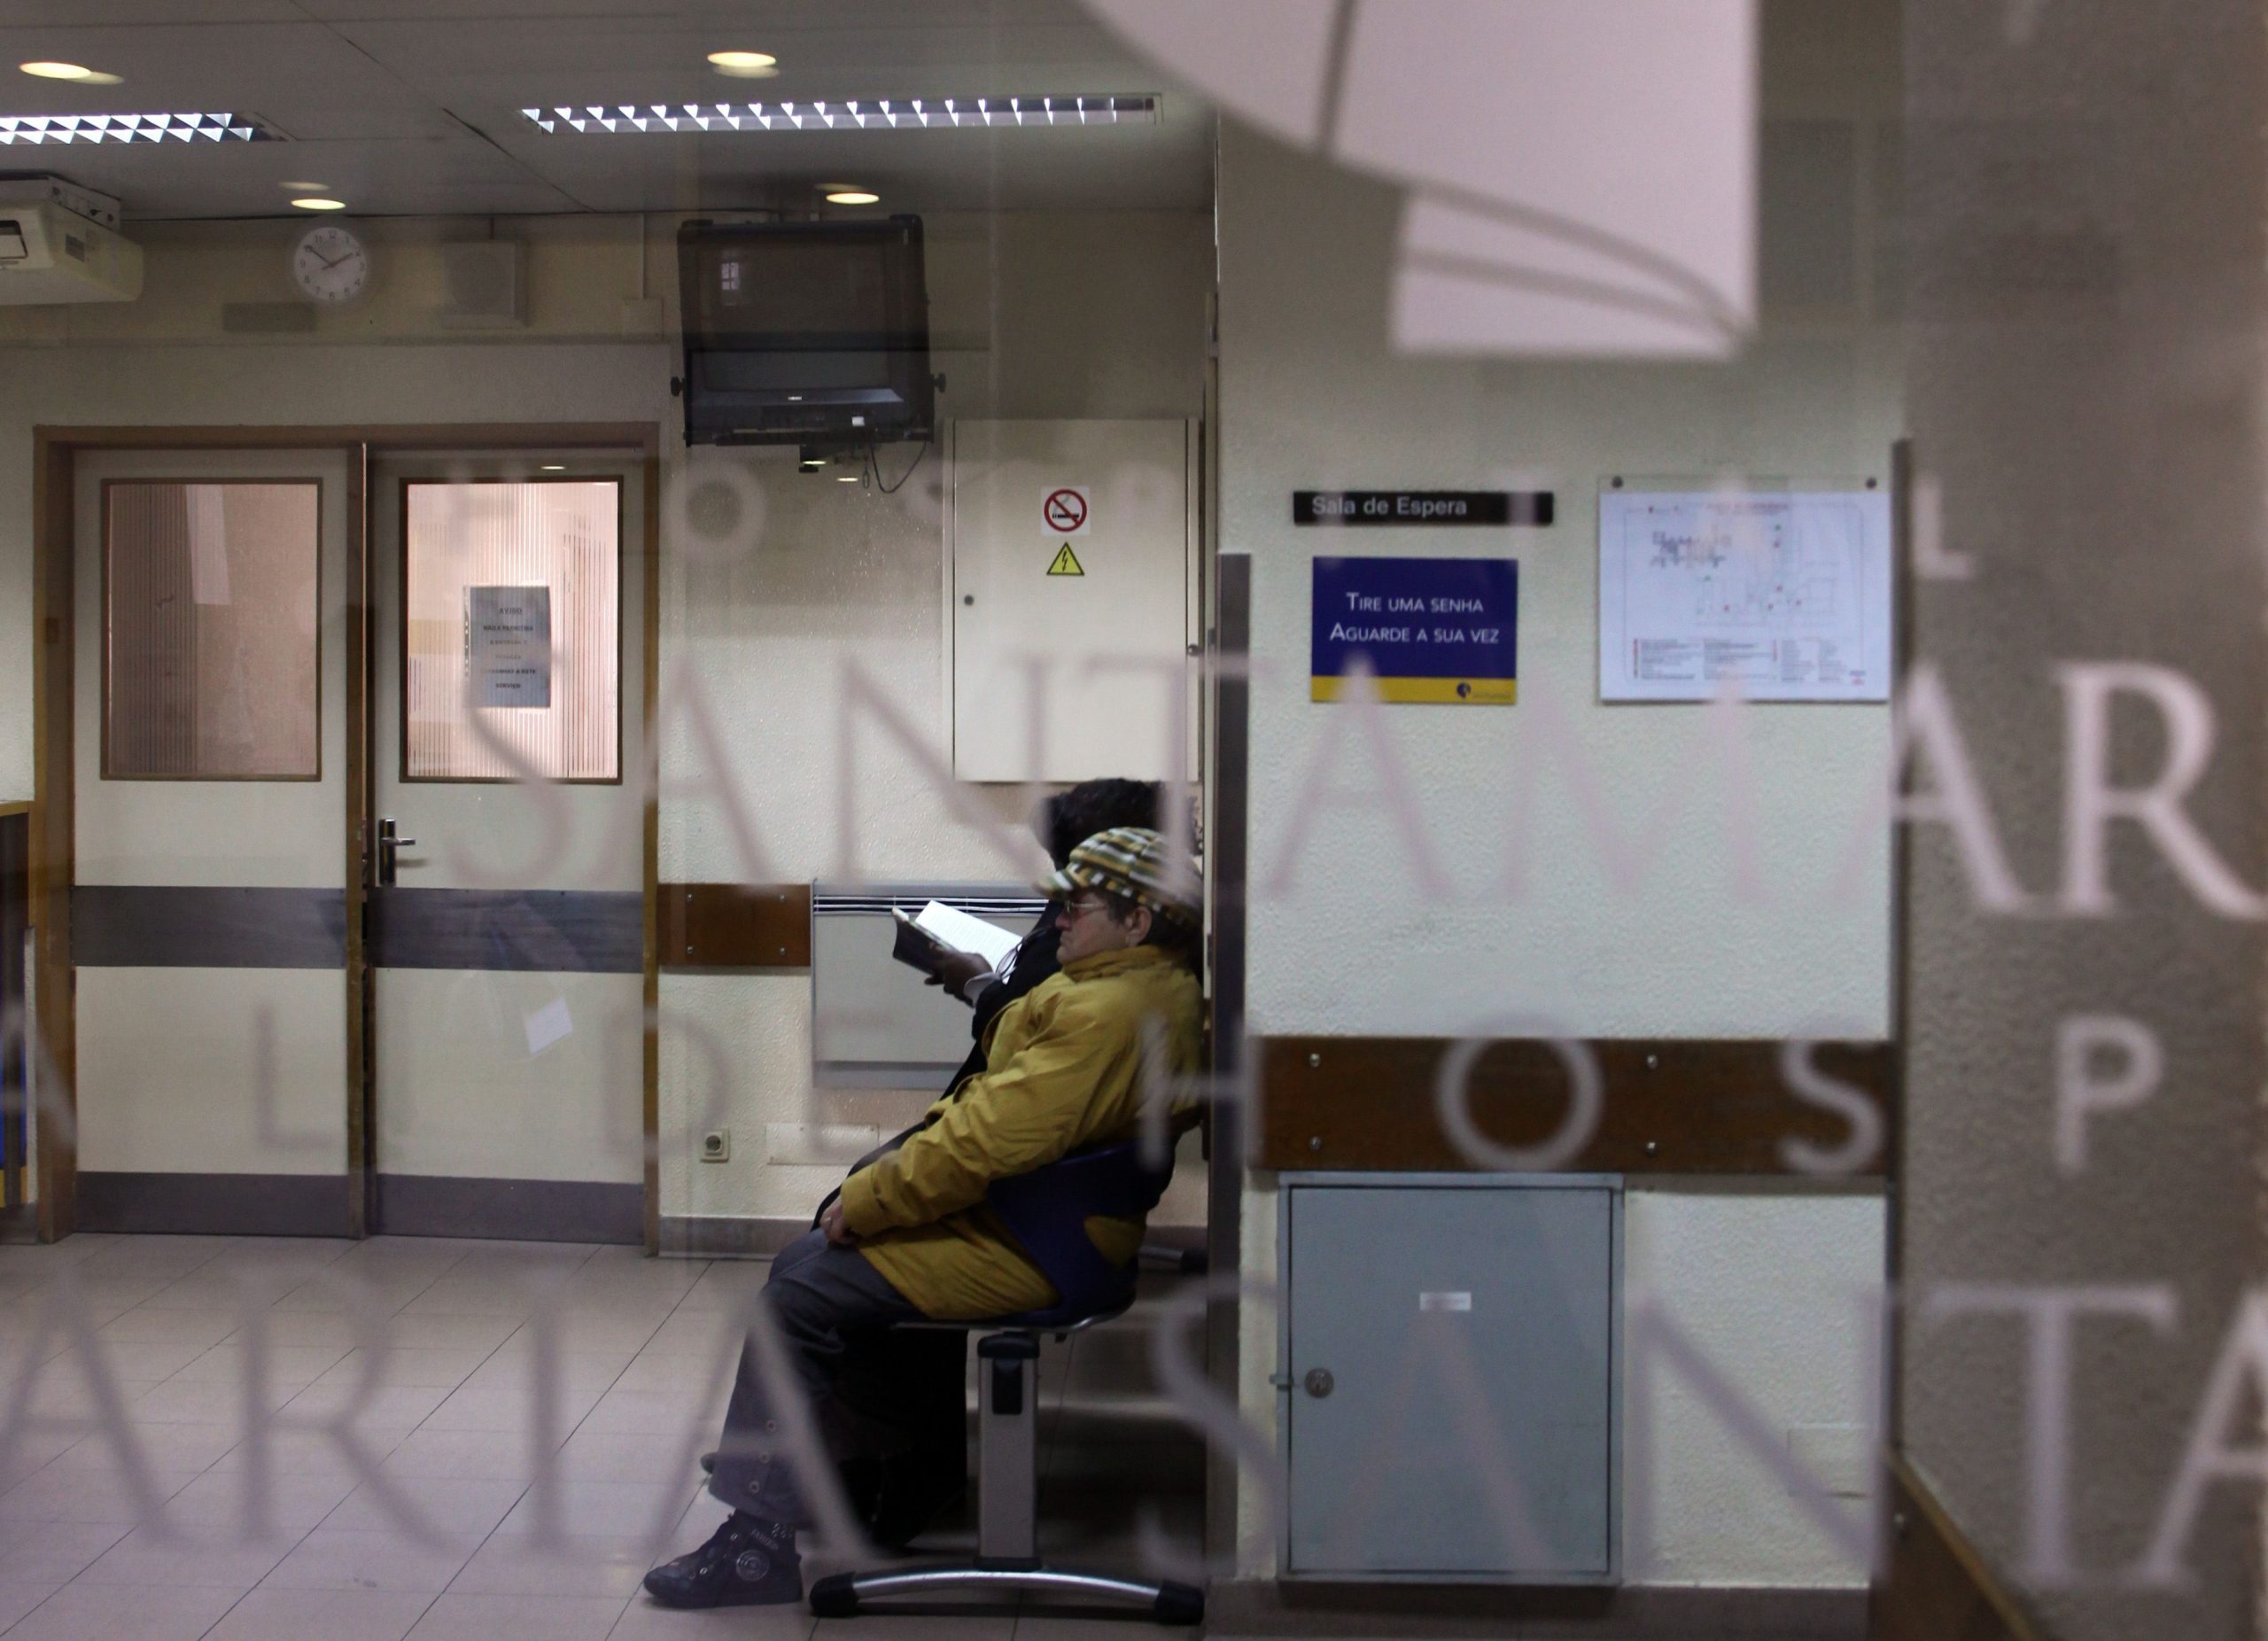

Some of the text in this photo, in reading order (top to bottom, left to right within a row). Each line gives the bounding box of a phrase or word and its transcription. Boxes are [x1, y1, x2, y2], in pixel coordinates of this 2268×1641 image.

[1312, 496, 1467, 518] Sala de Espera
[1347, 592, 1483, 613] TIRE UMA SENHA
[1330, 622, 1500, 644] AGUARDE A SUA VEZ
